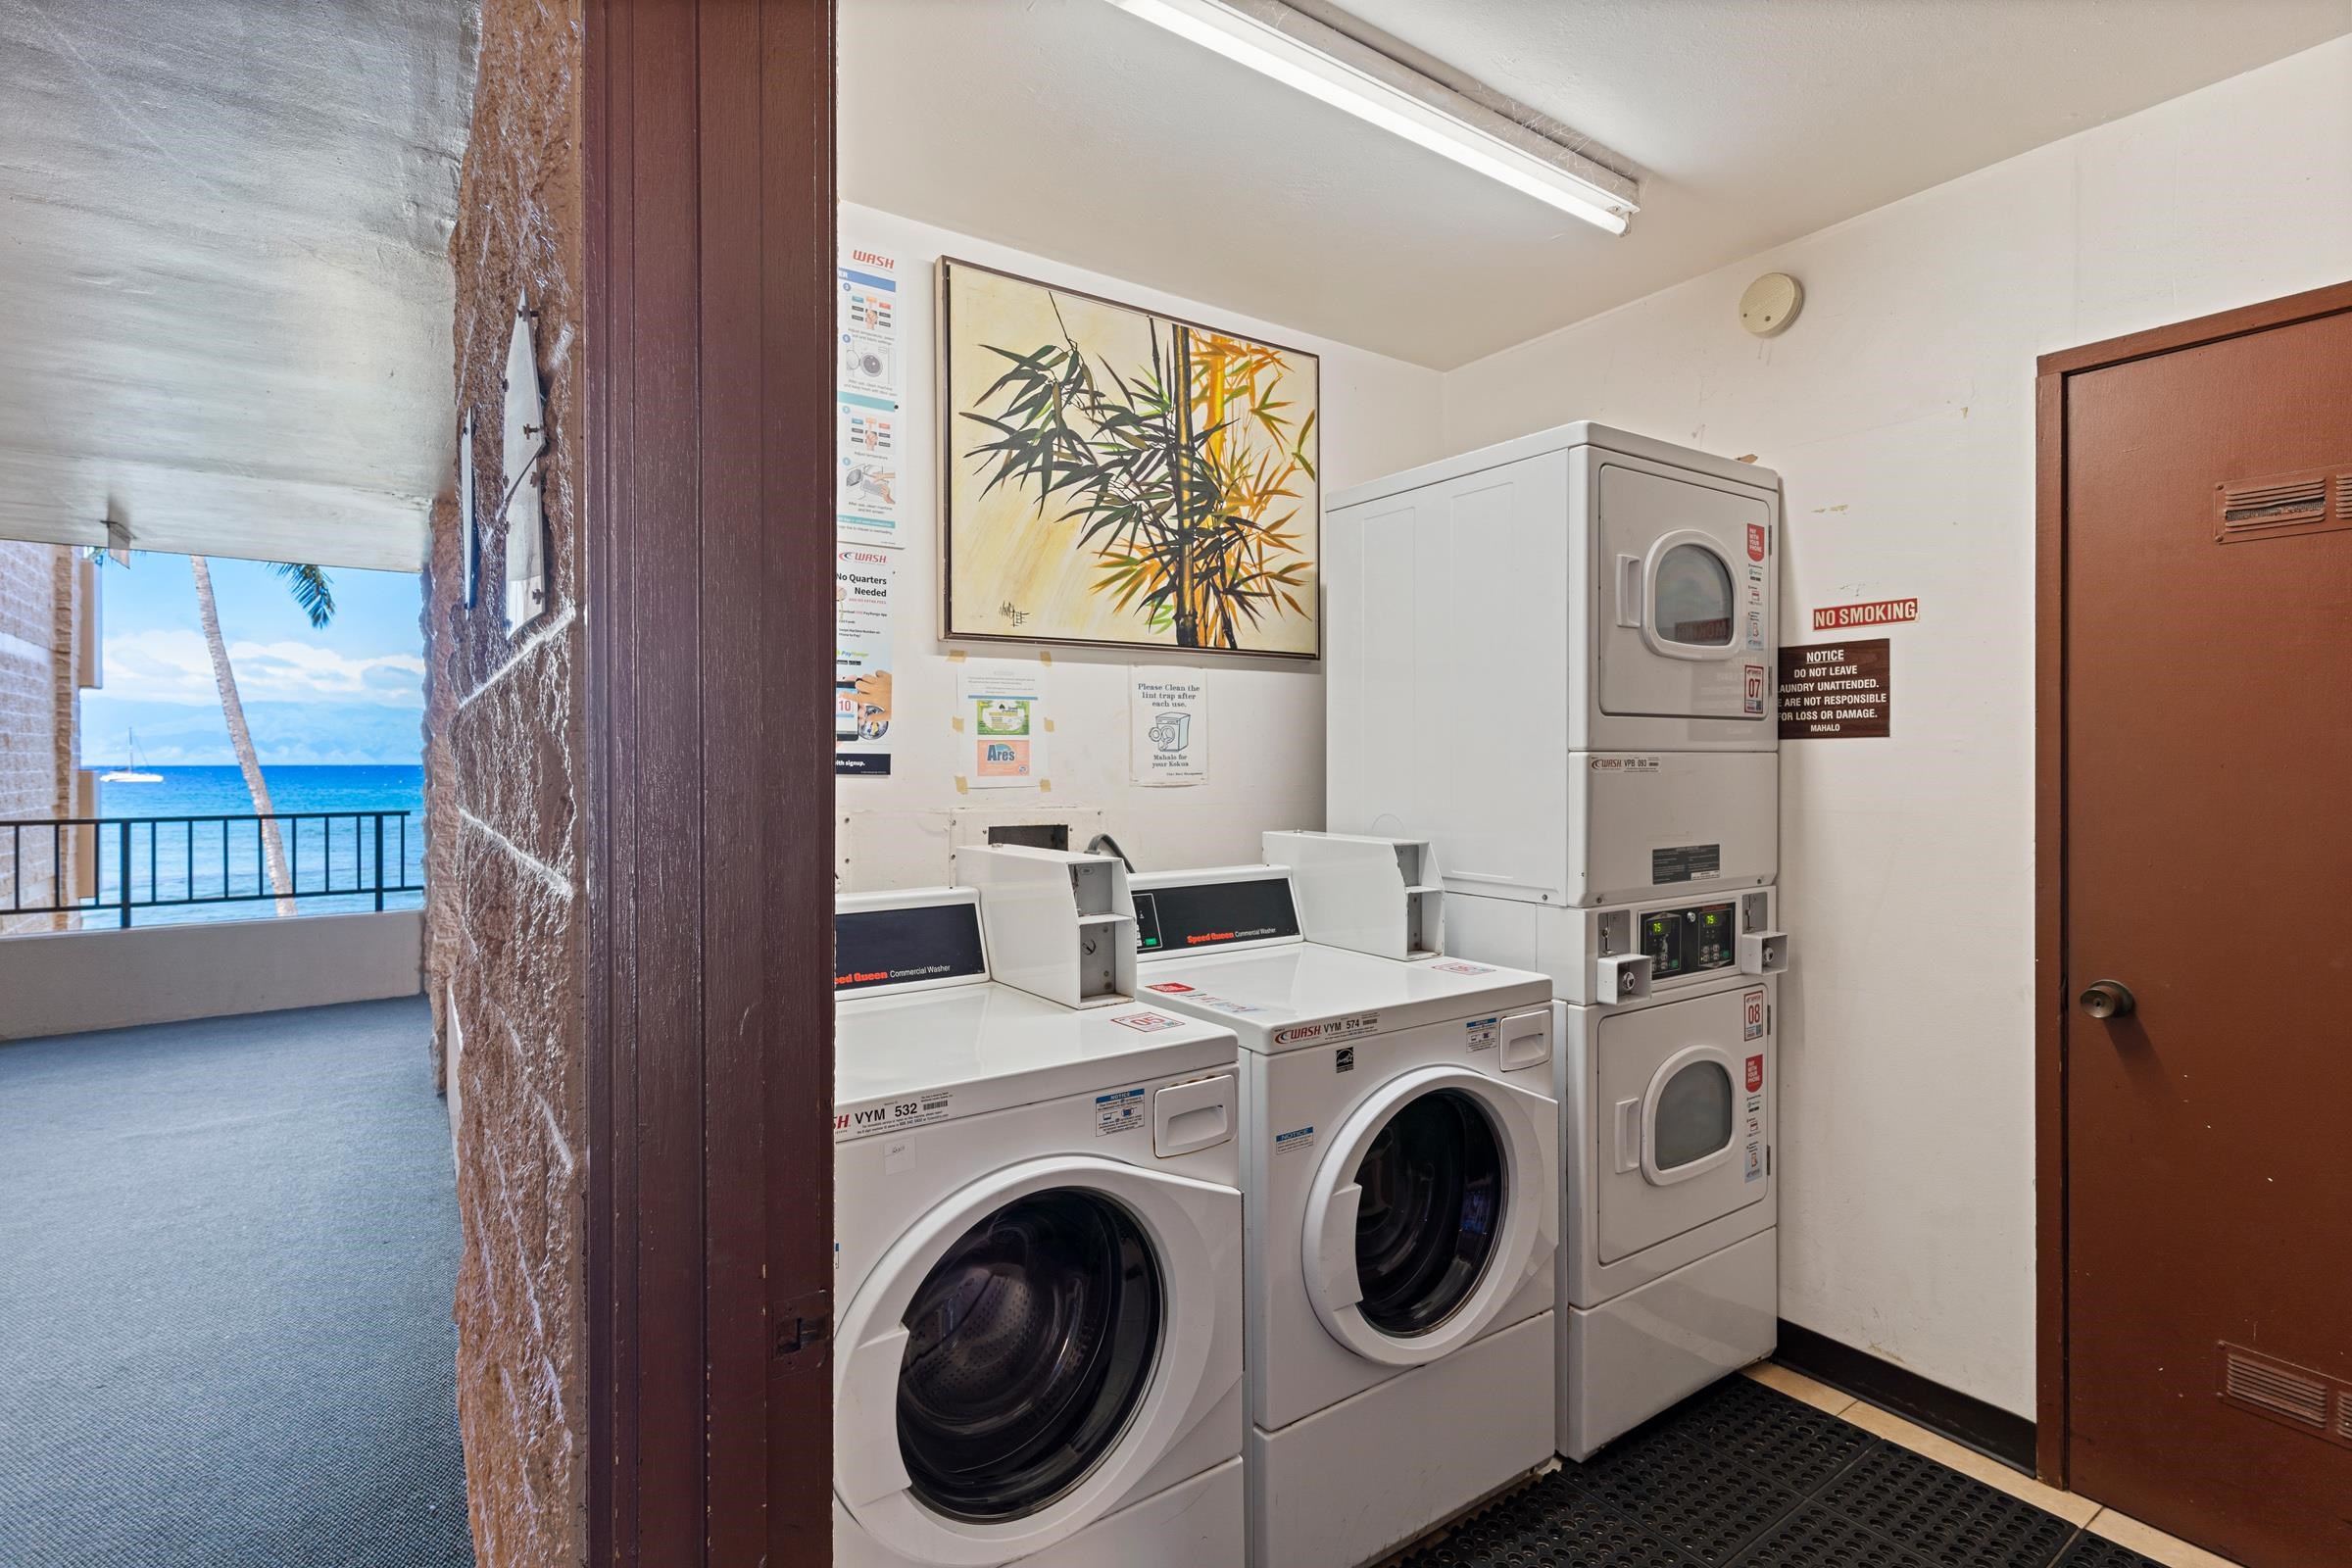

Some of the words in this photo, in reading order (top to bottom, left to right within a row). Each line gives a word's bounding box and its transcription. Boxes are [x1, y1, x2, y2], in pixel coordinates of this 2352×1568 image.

[853, 249, 894, 270] WASH
[855, 552, 887, 563] WASH
[836, 573, 847, 581] No
[849, 574, 887, 585] Quarters
[855, 587, 887, 597] Needed
[1815, 610, 1835, 627] NO
[1839, 601, 1916, 625] SMOKING
[1807, 649, 1844, 663] NOTICE
[1794, 669, 1806, 678] DO
[1809, 667, 1827, 677] NOT
[1829, 665, 1857, 676] LEAVE
[1749, 678, 1761, 698] 07
[1818, 679, 1879, 691] UNATTENDED.
[839, 700, 851, 711] 10
[1784, 697, 1801, 706] ARE
[1804, 697, 1821, 706] NOT
[1824, 693, 1886, 705] RESPONSIBLE
[1796, 710, 1818, 720] LOSS
[1821, 710, 1833, 719] OR
[1836, 709, 1877, 718] DAMAGE.
[1811, 724, 1840, 732] MAHALO
[1602, 759, 1622, 768] WASH
[1187, 933, 1210, 944] Speed
[1235, 929, 1260, 938] Commercial
[834, 974, 853, 984] eed
[854, 971, 888, 982] Queen
[889, 967, 927, 978] Commercial
[927, 965, 950, 973] Washer
[1748, 1003, 1760, 1024] 08
[1130, 1016, 1165, 1025] 05
[1290, 1025, 1321, 1039] WASH
[1323, 1022, 1341, 1033] VYM
[1347, 1019, 1360, 1029] 574
[854, 1108, 885, 1124] VYM
[894, 1102, 918, 1117] 532
